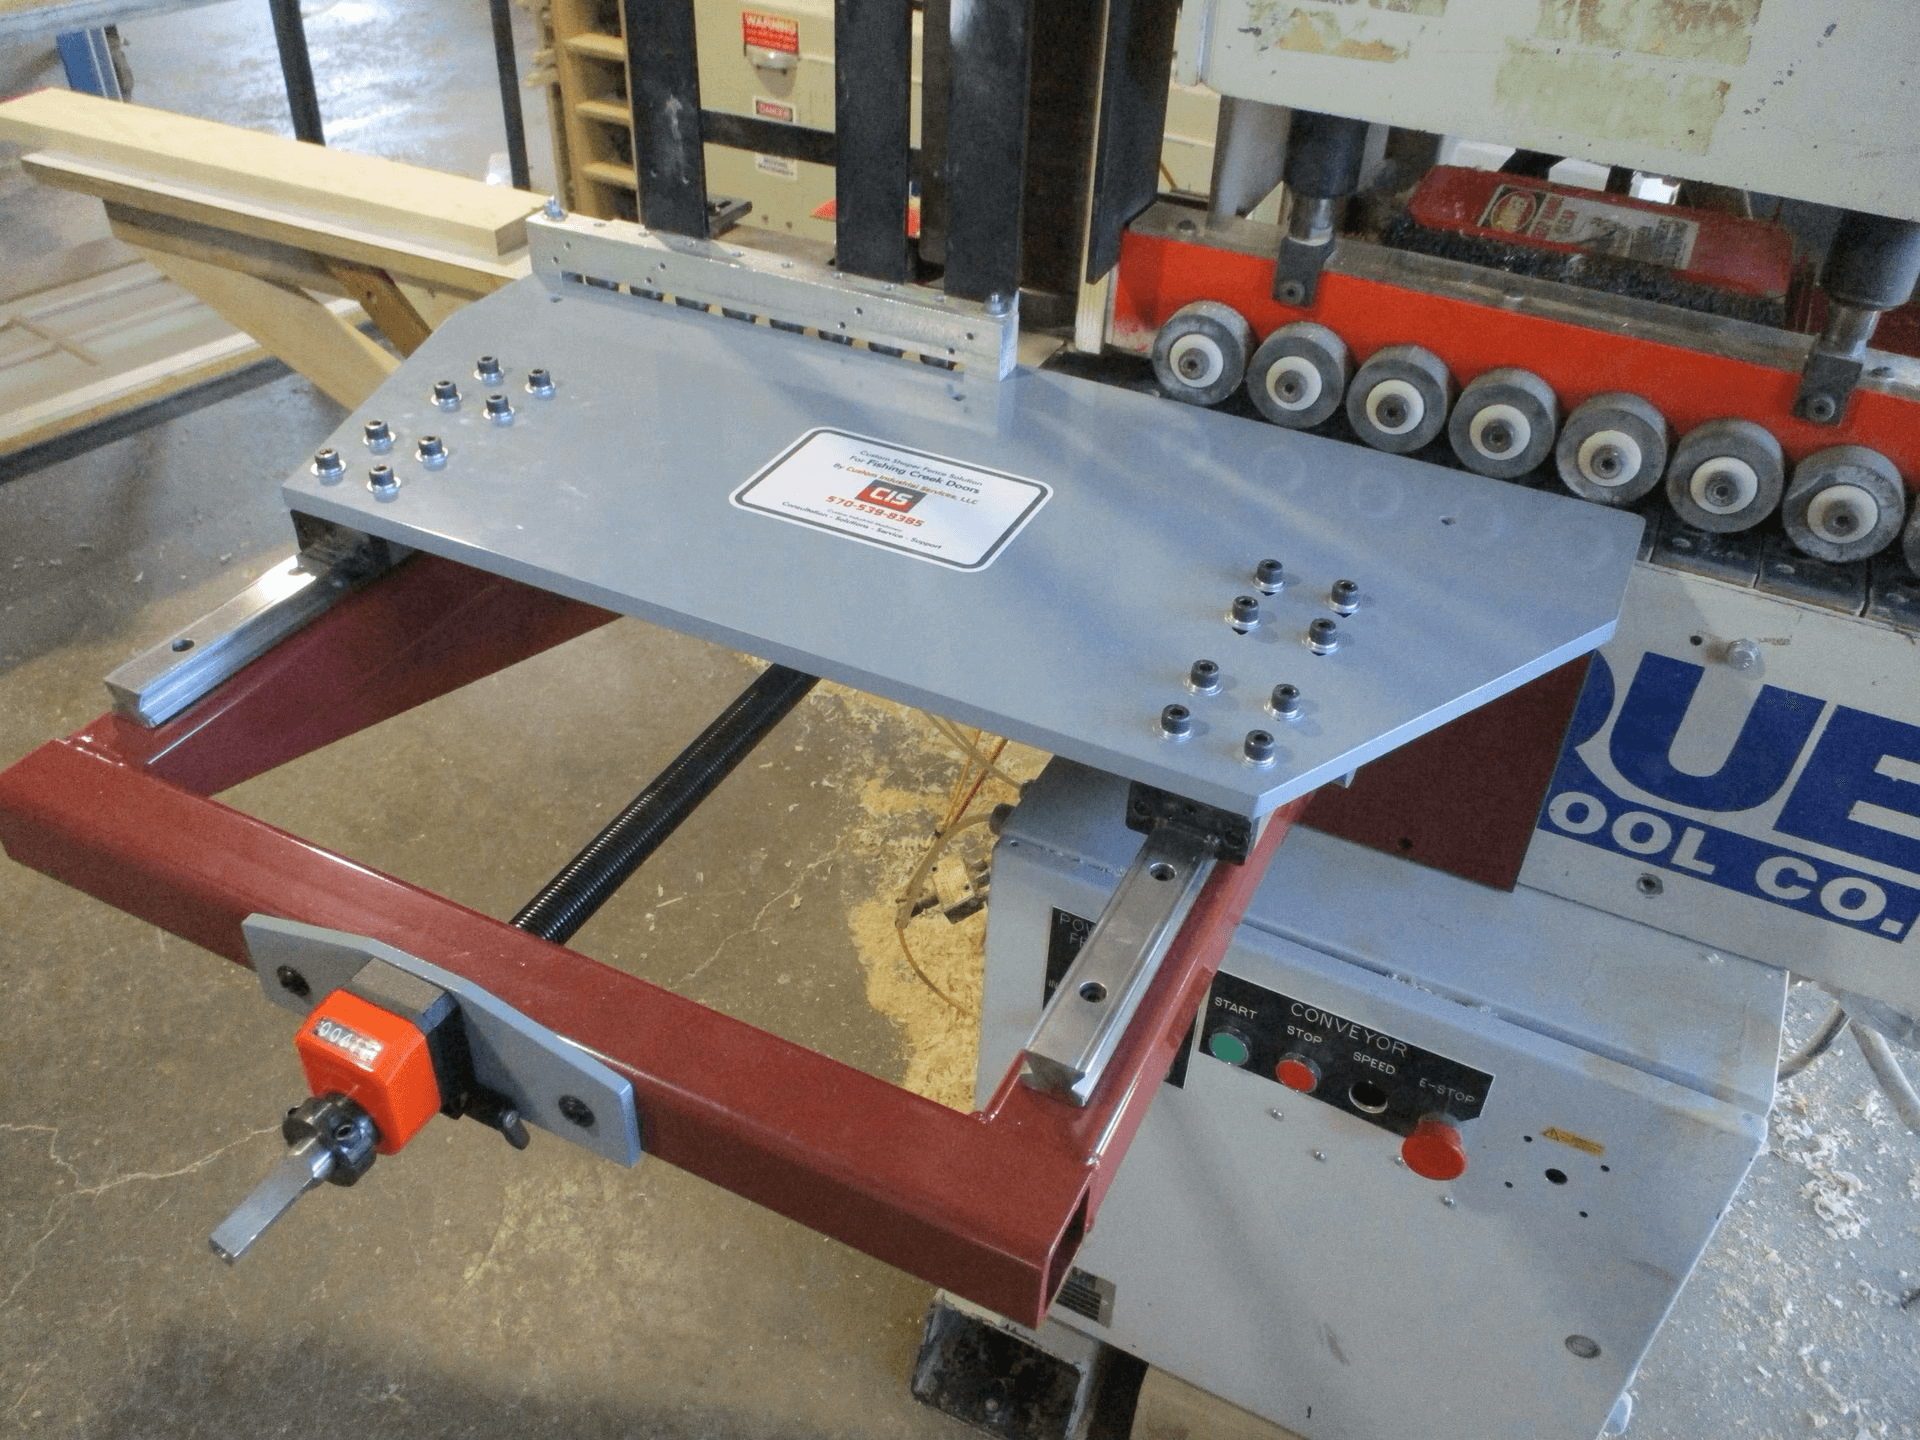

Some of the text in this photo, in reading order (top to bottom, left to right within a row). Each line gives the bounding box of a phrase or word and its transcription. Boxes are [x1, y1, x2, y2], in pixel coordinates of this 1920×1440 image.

[849, 455, 980, 494] For Fishing Creek Doors
[860, 450, 890, 462] Custom
[923, 466, 947, 477] Fence
[950, 473, 983, 487] Solution
[868, 486, 914, 506] CIS
[960, 496, 979, 505] LLC
[781, 501, 942, 549] Consultation Solutions Service Support
[1755, 856, 1903, 935] CO.
[1213, 996, 1258, 1020] START
[1286, 1025, 1323, 1044] STOP
[1290, 1002, 1408, 1058] CONVEYOR
[1353, 1051, 1396, 1076] SPEED
[1418, 1077, 1476, 1104] E-STOP
